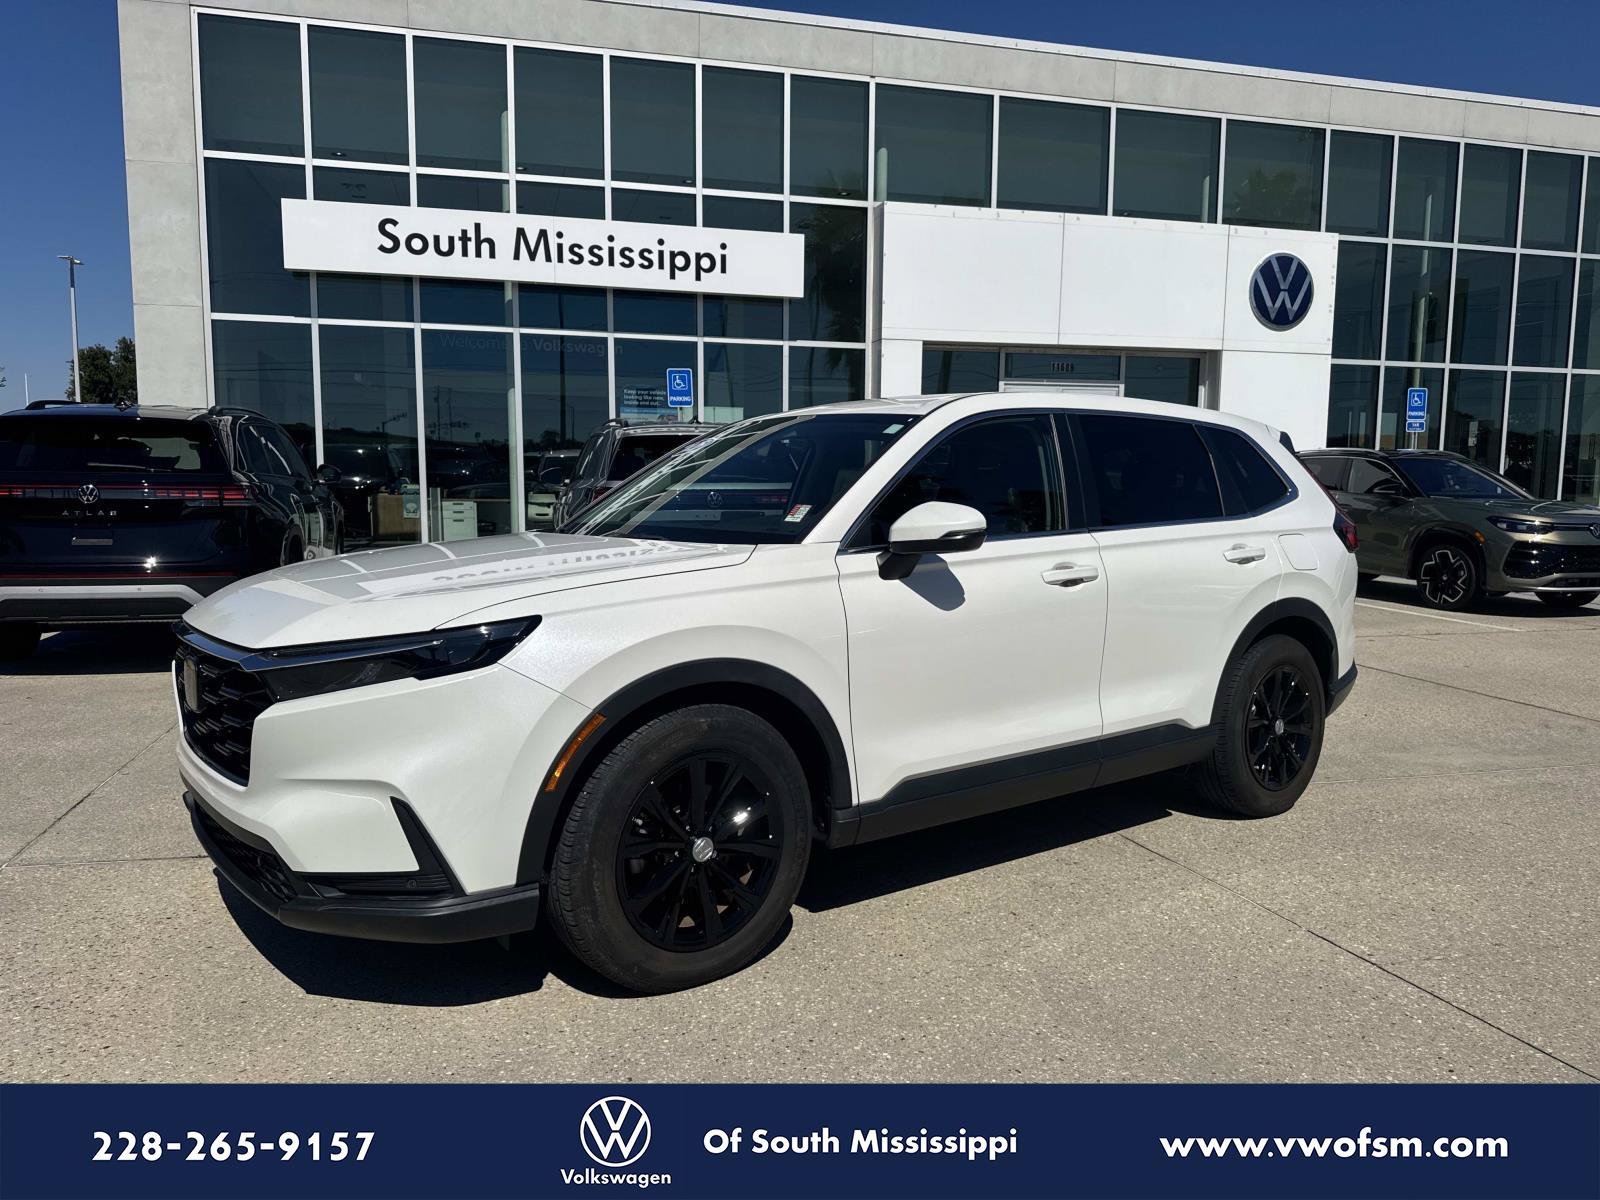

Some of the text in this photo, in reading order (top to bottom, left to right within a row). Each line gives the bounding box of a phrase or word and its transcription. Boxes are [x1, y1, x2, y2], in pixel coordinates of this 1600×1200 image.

[377, 218, 728, 281] South Mississippi
[1249, 252, 1314, 332] VW
